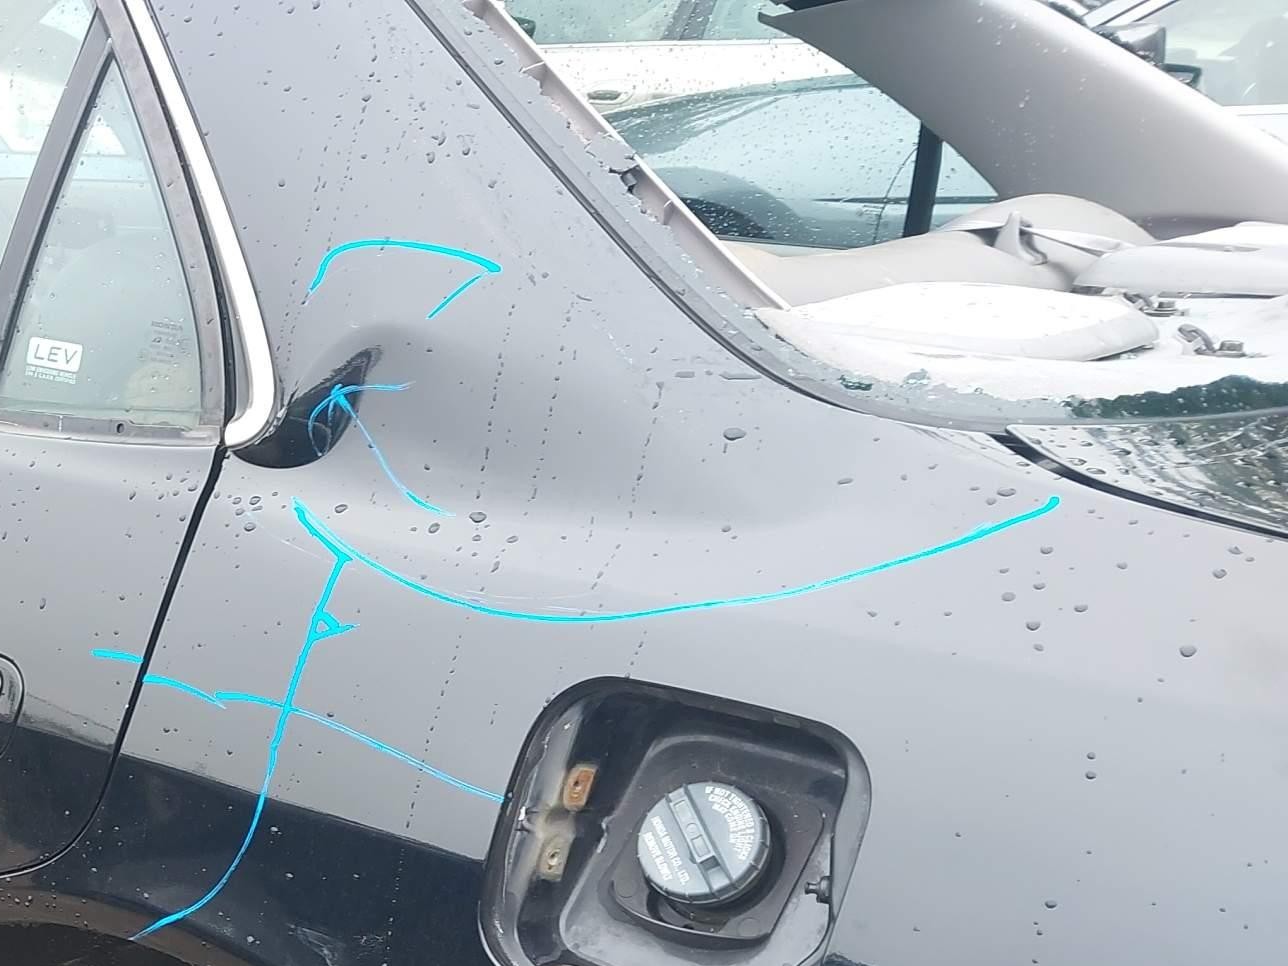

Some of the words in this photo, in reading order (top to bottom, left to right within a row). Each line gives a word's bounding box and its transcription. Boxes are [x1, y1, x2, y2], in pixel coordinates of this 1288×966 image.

[33, 343, 79, 365] LEV
[642, 831, 662, 858] REMOVE
[650, 815, 669, 837] HONDA
[661, 835, 678, 859] MOTOR
